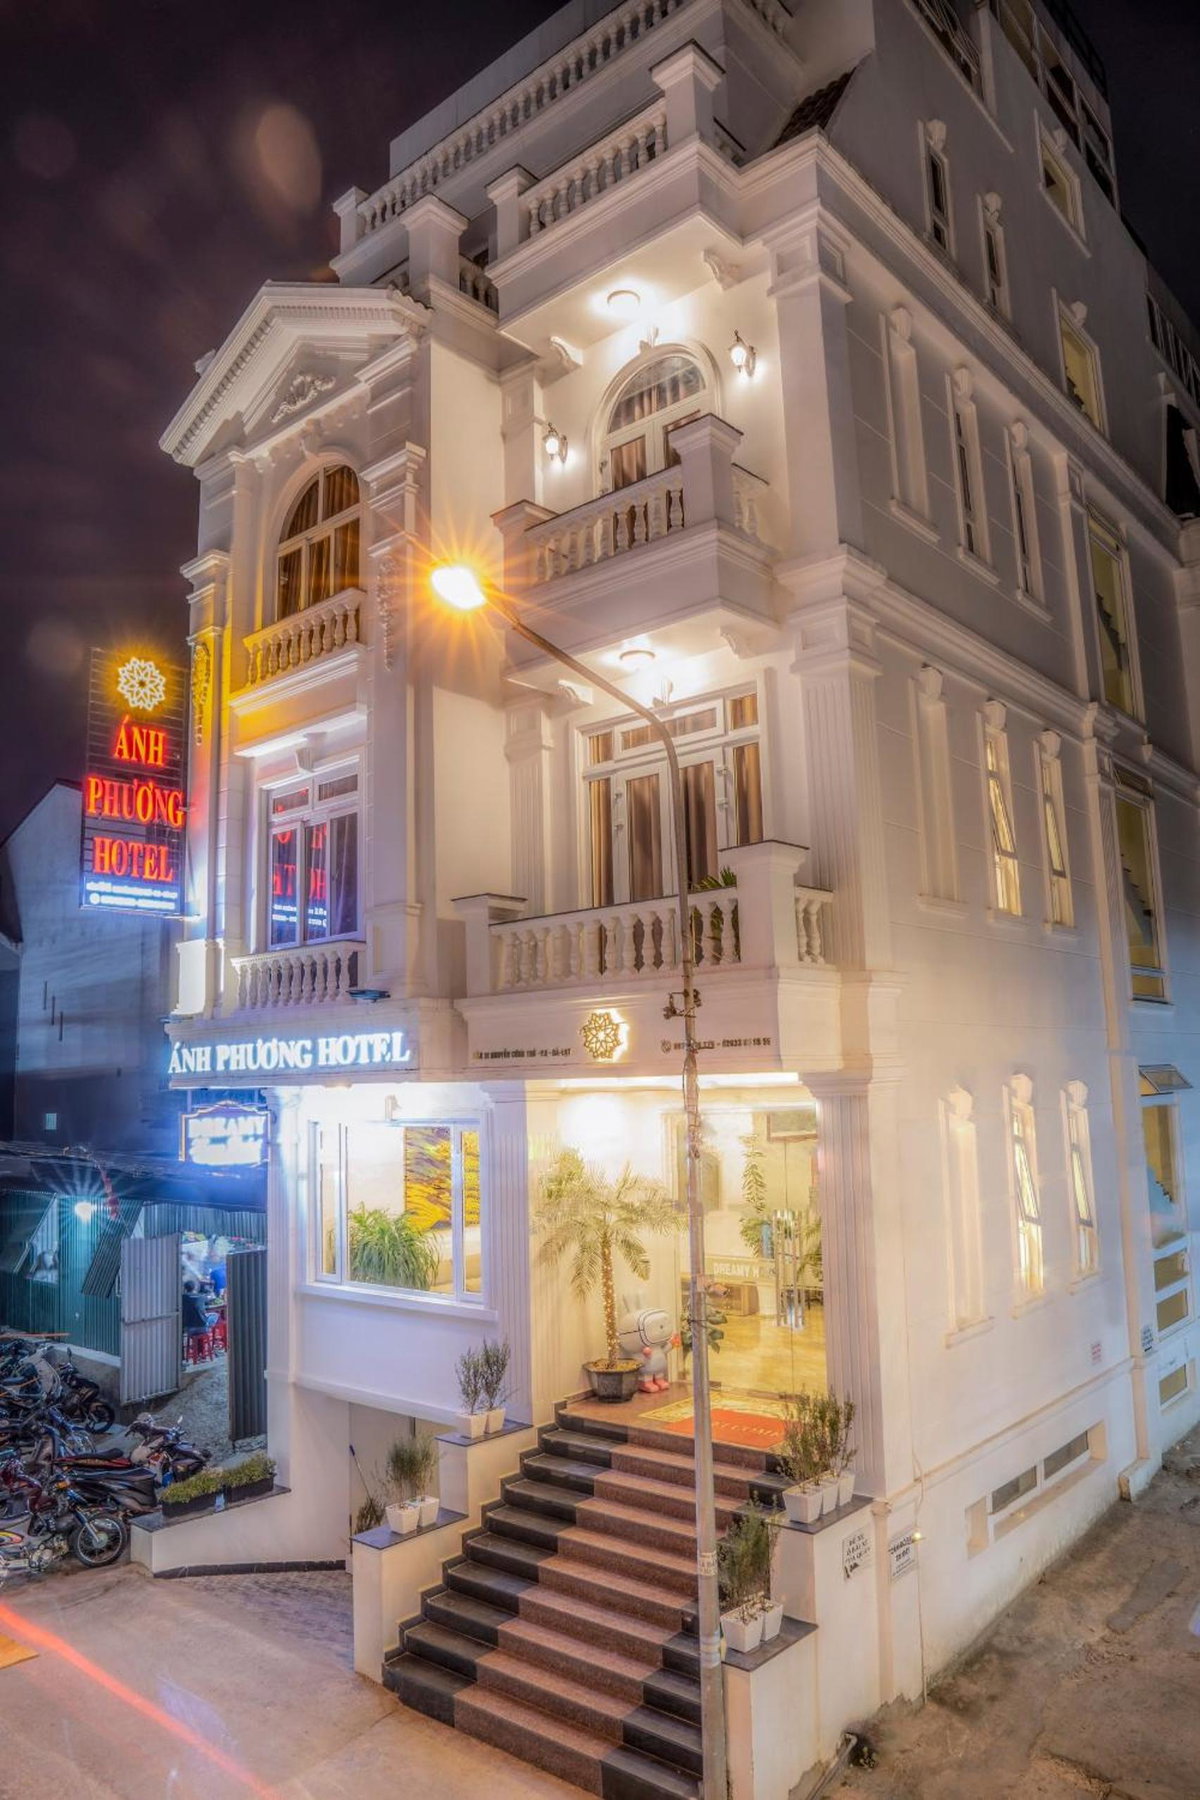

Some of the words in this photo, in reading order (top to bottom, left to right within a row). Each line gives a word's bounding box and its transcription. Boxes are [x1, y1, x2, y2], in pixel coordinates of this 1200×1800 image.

[113, 715, 166, 767] ÁNH
[87, 777, 185, 828] PHƯƠNG
[92, 836, 174, 883] HOTEL
[168, 1041, 211, 1074] ÁNH
[216, 1037, 313, 1072] PHƯƠNG
[317, 1031, 411, 1067] HOTEL
